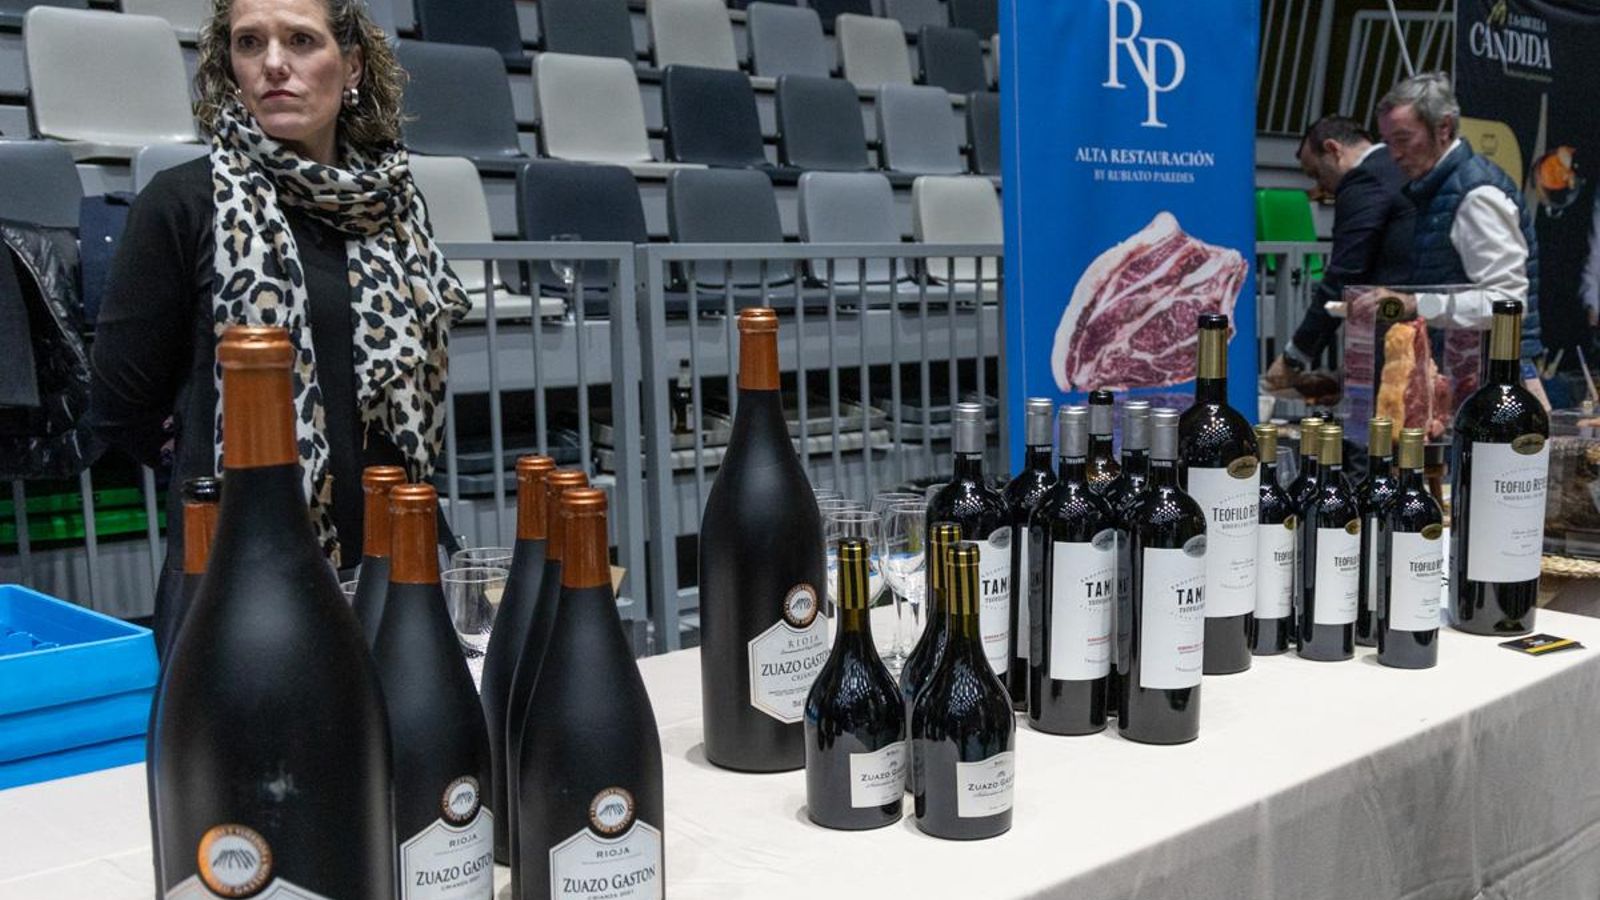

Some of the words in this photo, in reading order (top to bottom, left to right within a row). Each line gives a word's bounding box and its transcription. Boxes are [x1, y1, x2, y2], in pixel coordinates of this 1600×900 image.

[1075, 147, 1107, 162] ALTA
[1110, 149, 1215, 167] RESTAURACIÓN
[1094, 169, 1105, 181] BY
[1153, 172, 1195, 183] PAREDES
[788, 635, 819, 648] RIOJA
[761, 660, 801, 677] ZUAZO
[968, 782, 997, 791] ZUAZO
[449, 834, 477, 848] RIOJA
[596, 847, 630, 859] RIOJA
[416, 866, 460, 886] ZUAZO
[563, 877, 608, 893] ZUAZO
[612, 863, 656, 890] GASTON
